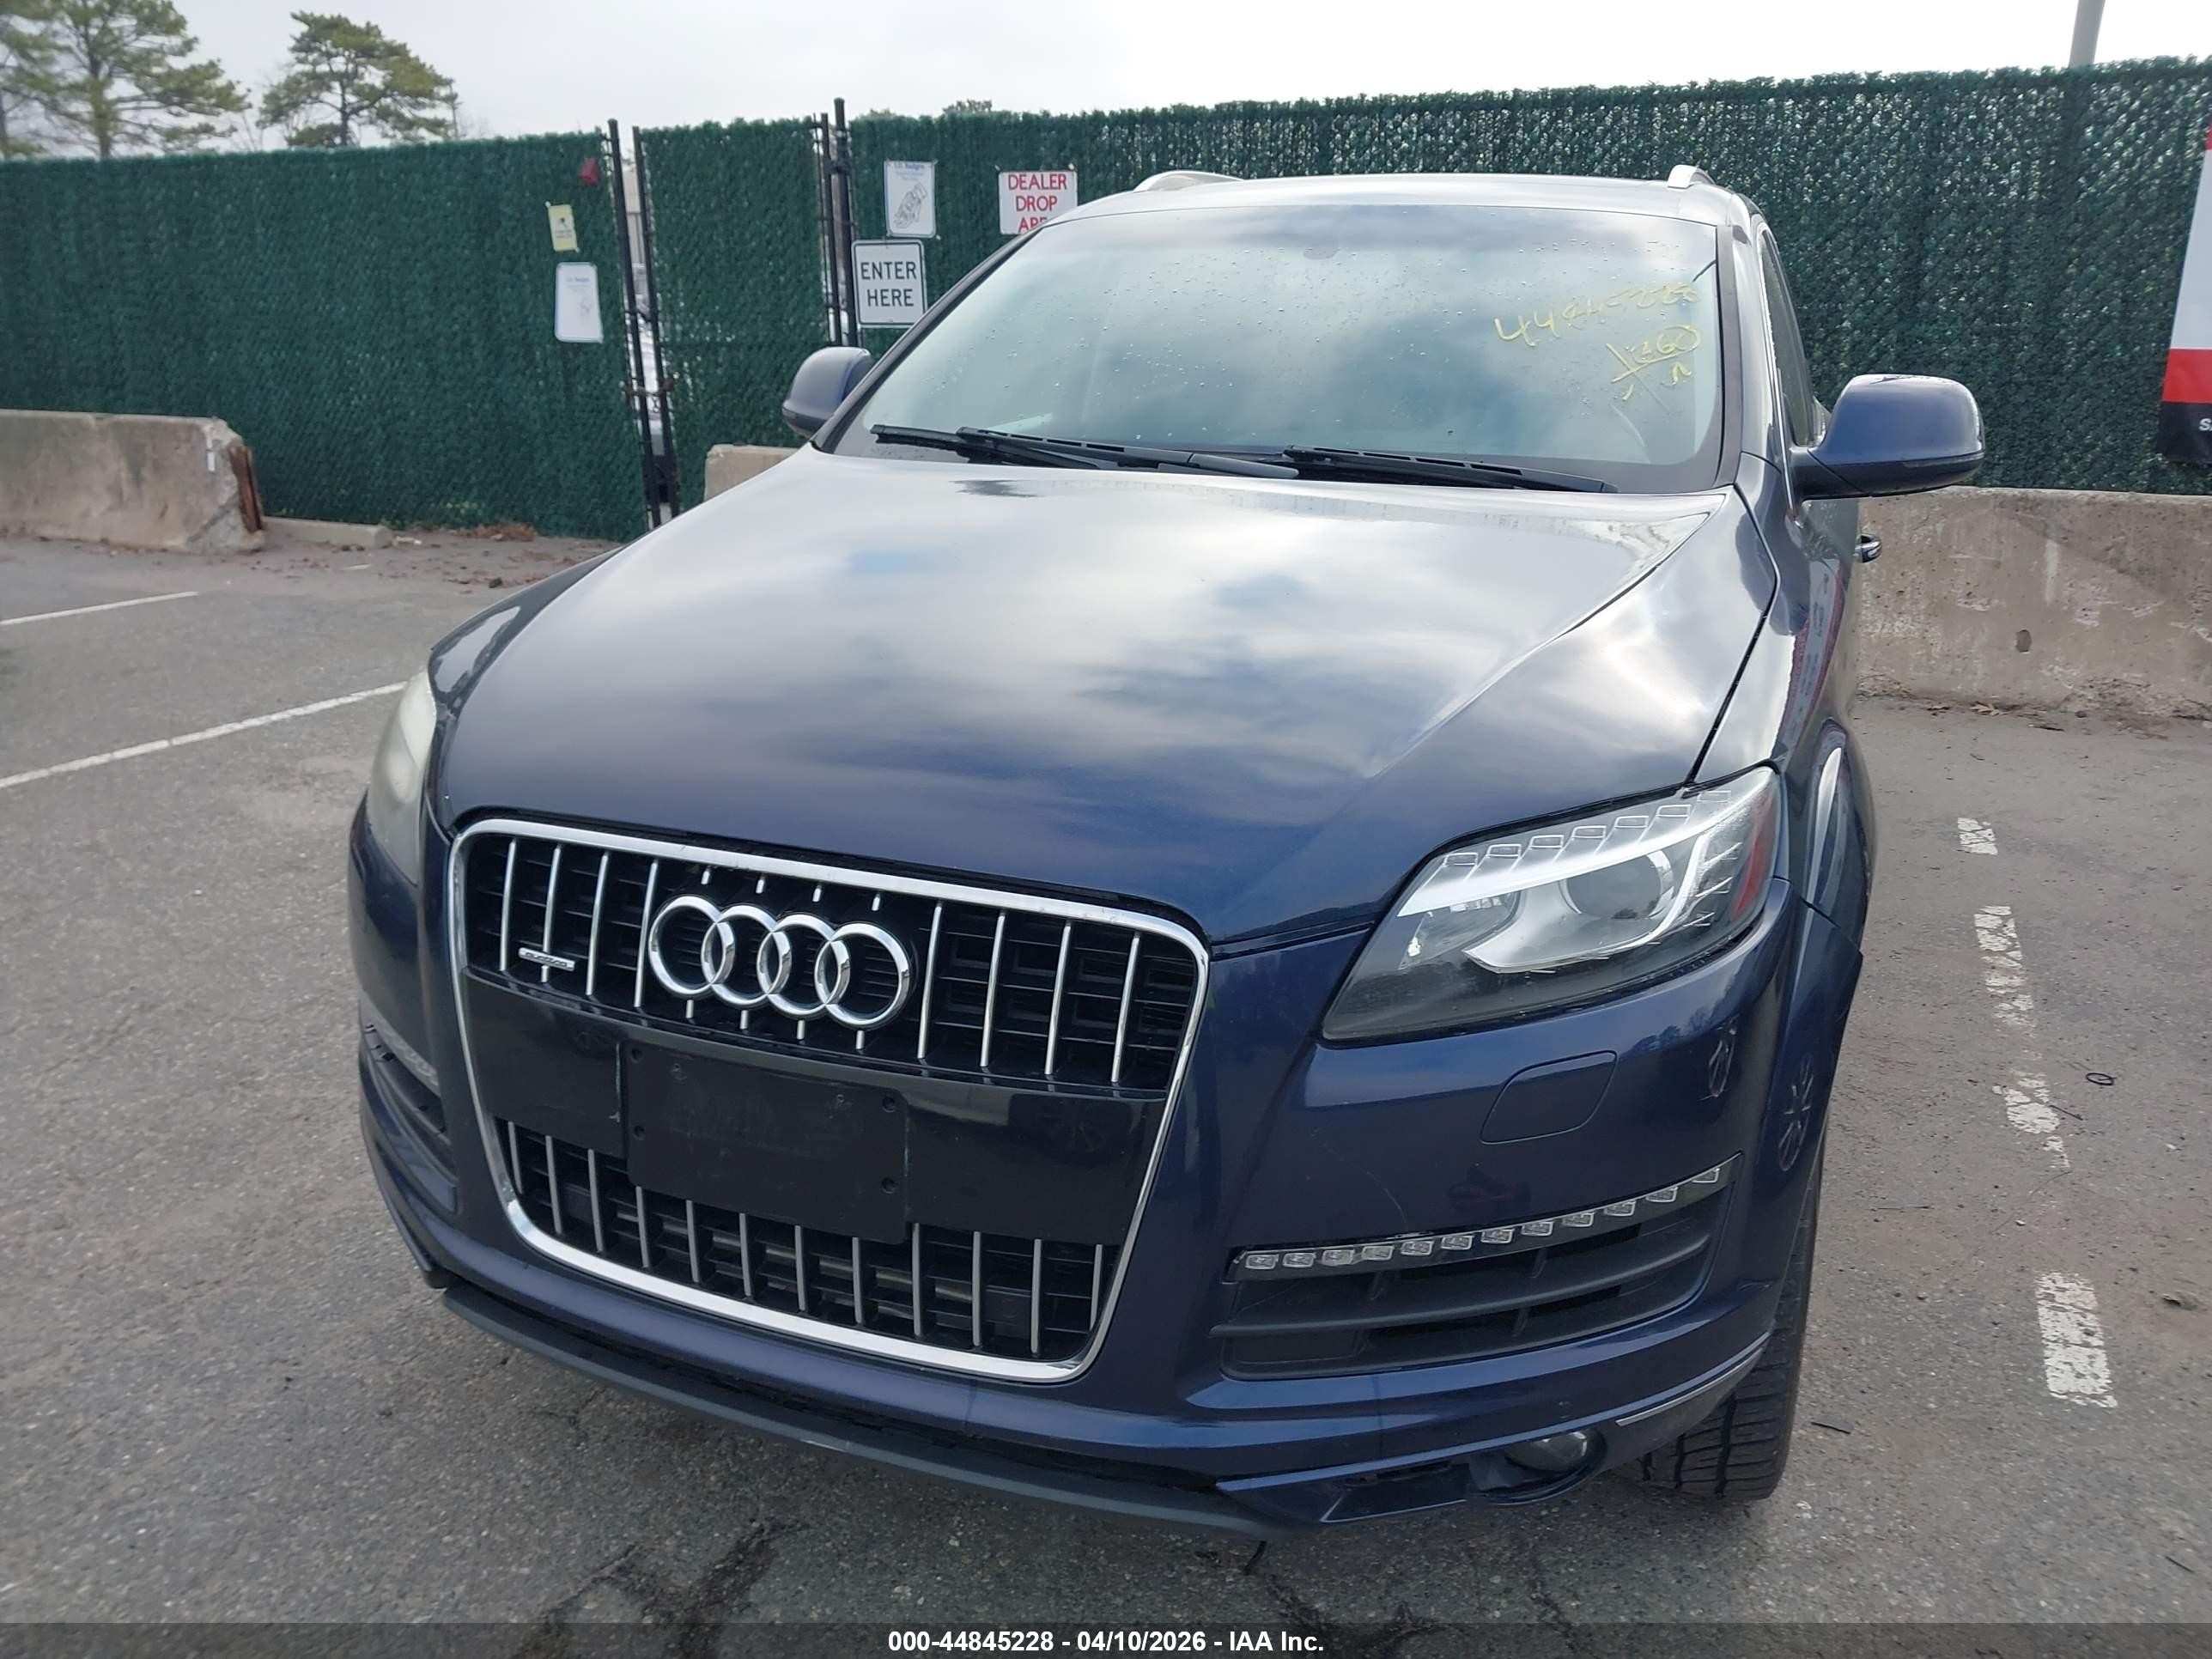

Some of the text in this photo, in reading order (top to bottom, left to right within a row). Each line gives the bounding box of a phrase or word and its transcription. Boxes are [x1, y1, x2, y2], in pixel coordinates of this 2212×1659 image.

[1008, 173, 1067, 190] DEALER
[1016, 195, 1058, 211] DROP
[1018, 217, 1048, 233] AR
[860, 261, 917, 280] ENTER
[866, 288, 915, 307] HERE
